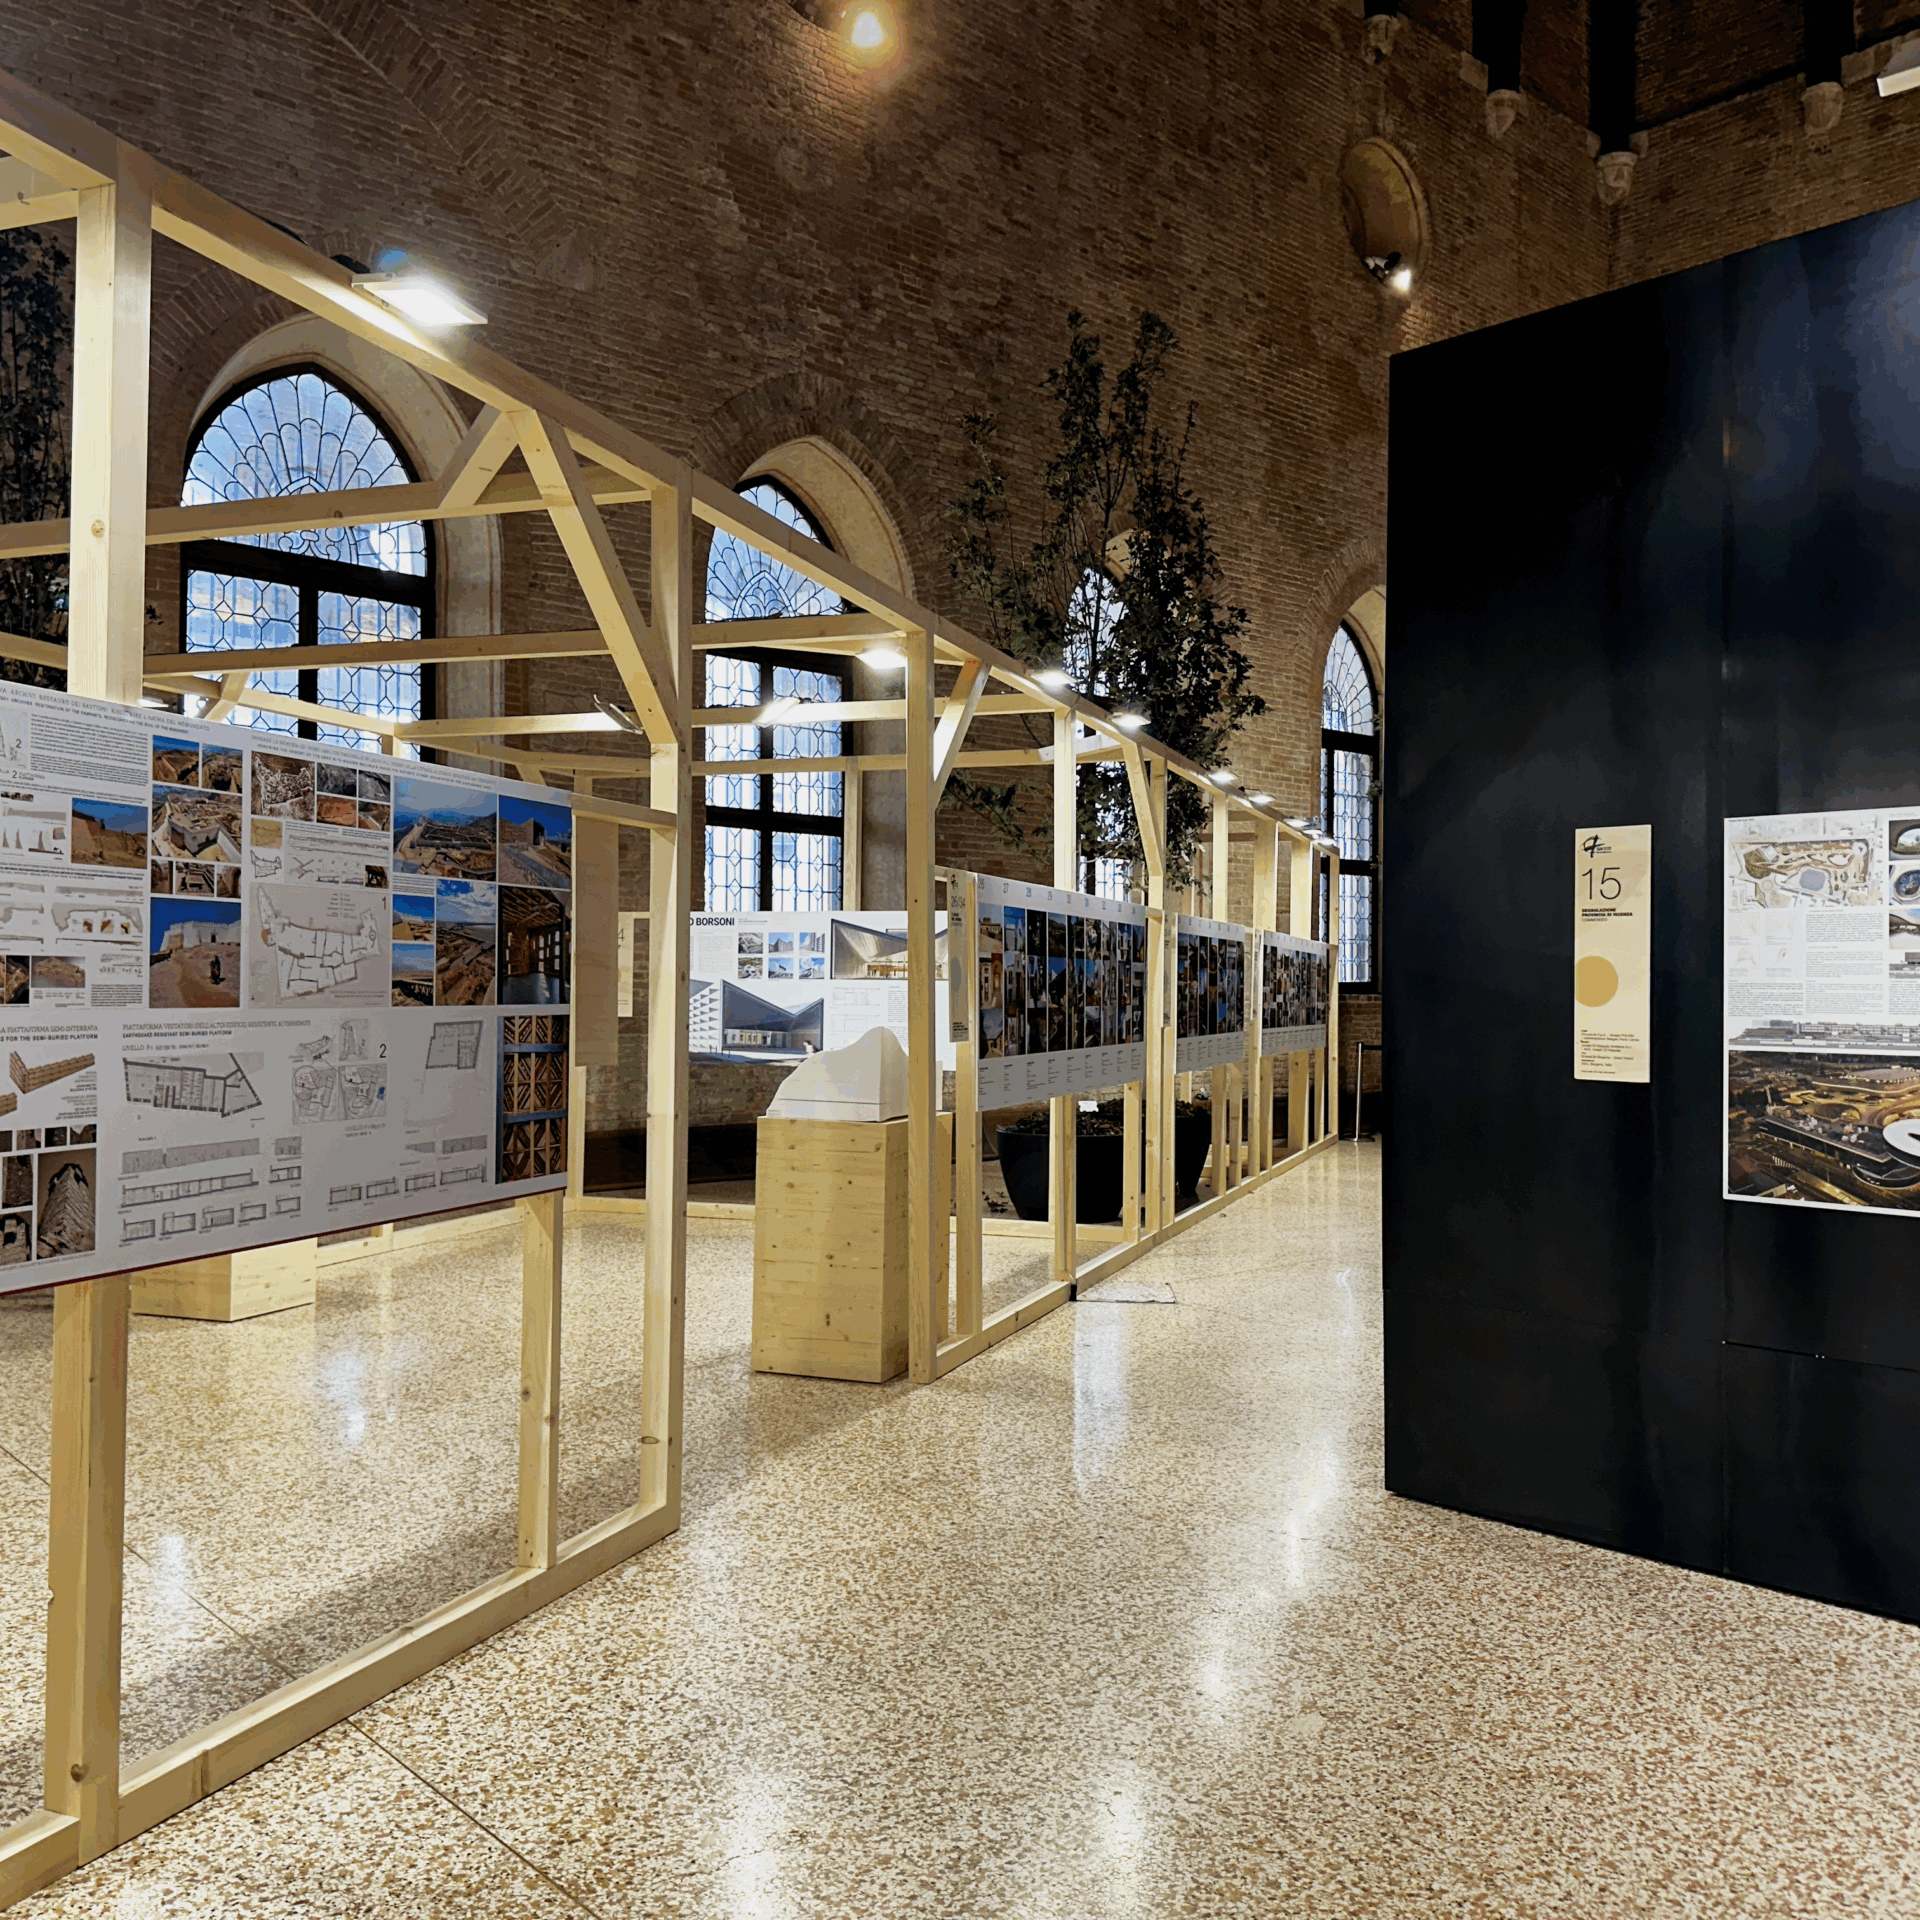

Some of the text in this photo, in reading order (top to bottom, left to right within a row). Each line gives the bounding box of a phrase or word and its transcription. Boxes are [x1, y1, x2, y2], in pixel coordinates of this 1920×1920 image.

[15, 738, 22, 749] 2
[12, 769, 18, 779] 2
[1003, 882, 1009, 893] 27
[1581, 867, 1621, 900] 15
[382, 896, 387, 910] 1
[696, 917, 735, 926] BORSONI
[7, 1025, 50, 1033] PIATTAFORMA
[50, 1024, 98, 1033] SEMI-INTERRATA
[122, 1022, 162, 1031] PIATTAFORMA
[379, 1043, 387, 1059] 2
